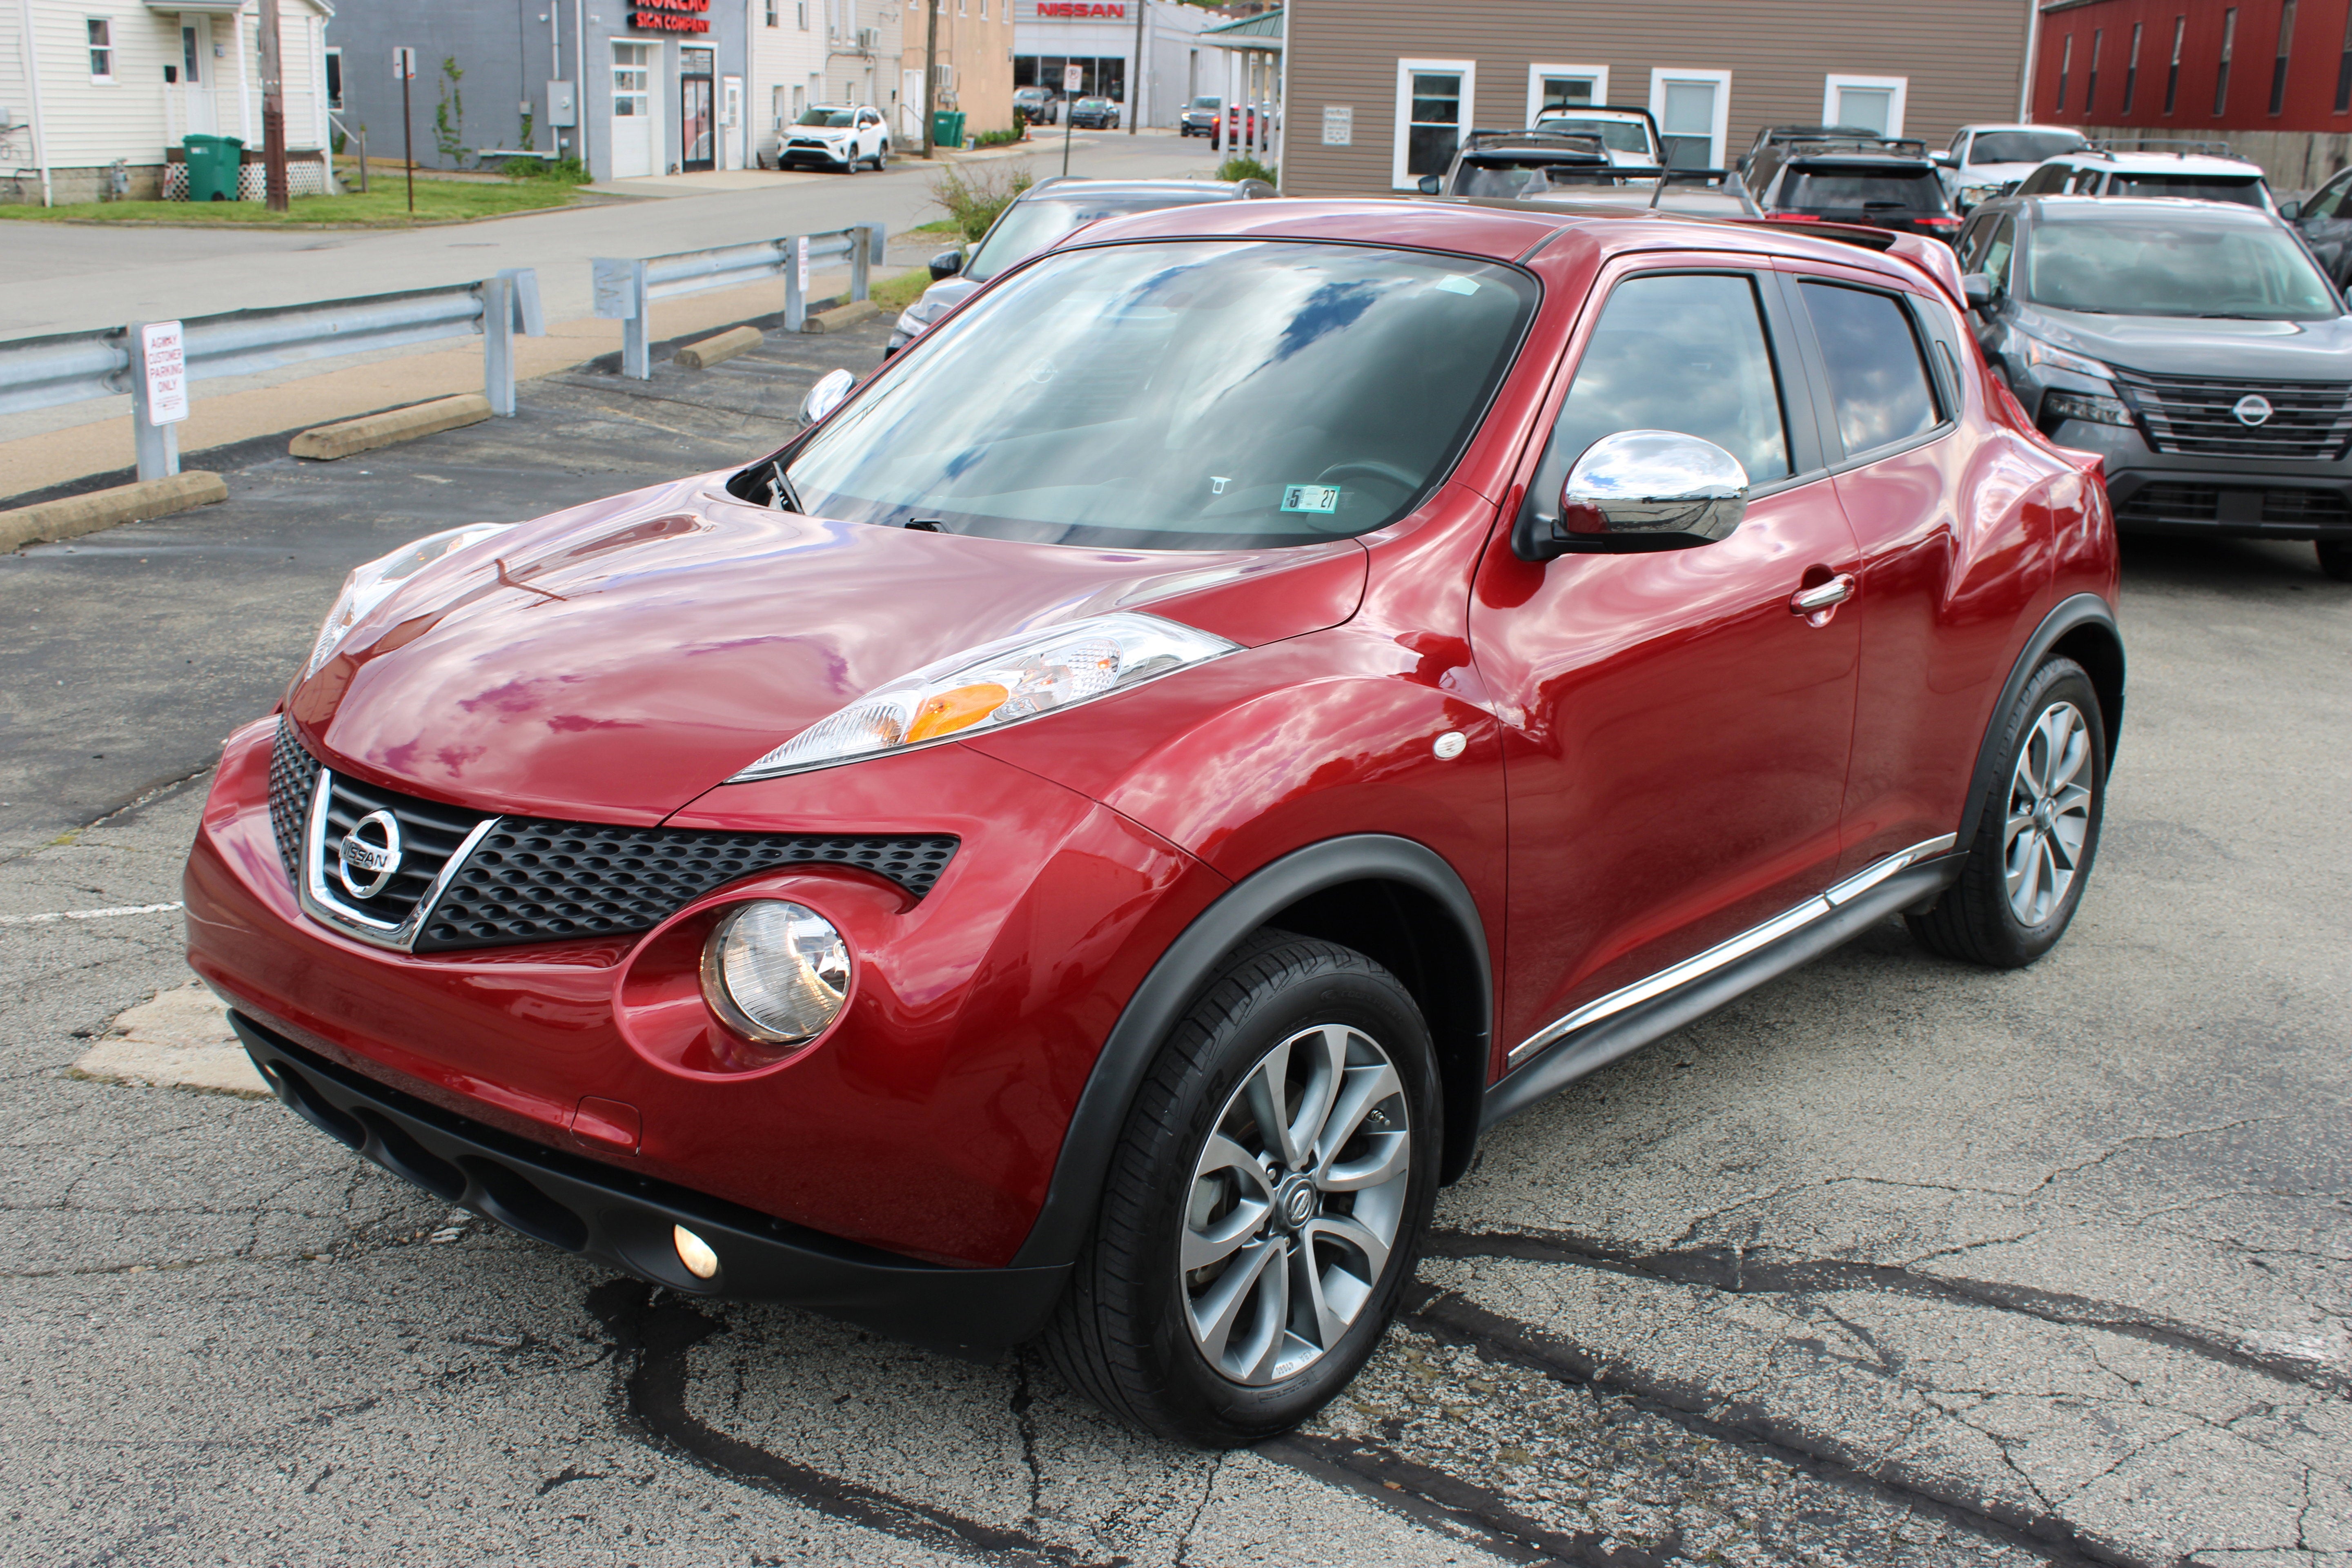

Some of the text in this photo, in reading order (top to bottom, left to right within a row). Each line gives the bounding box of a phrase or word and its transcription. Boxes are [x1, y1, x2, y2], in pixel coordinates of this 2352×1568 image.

[1038, 3, 1124, 17] NISSAN
[636, 11, 710, 32] SIGN COMPANY
[149, 348, 181, 364] CUSTOMER
[150, 363, 183, 379] PARKING
[158, 378, 177, 392] ONLY
[1290, 490, 1301, 508] 5
[1321, 490, 1335, 508] 27
[341, 841, 388, 867] NISSAN
